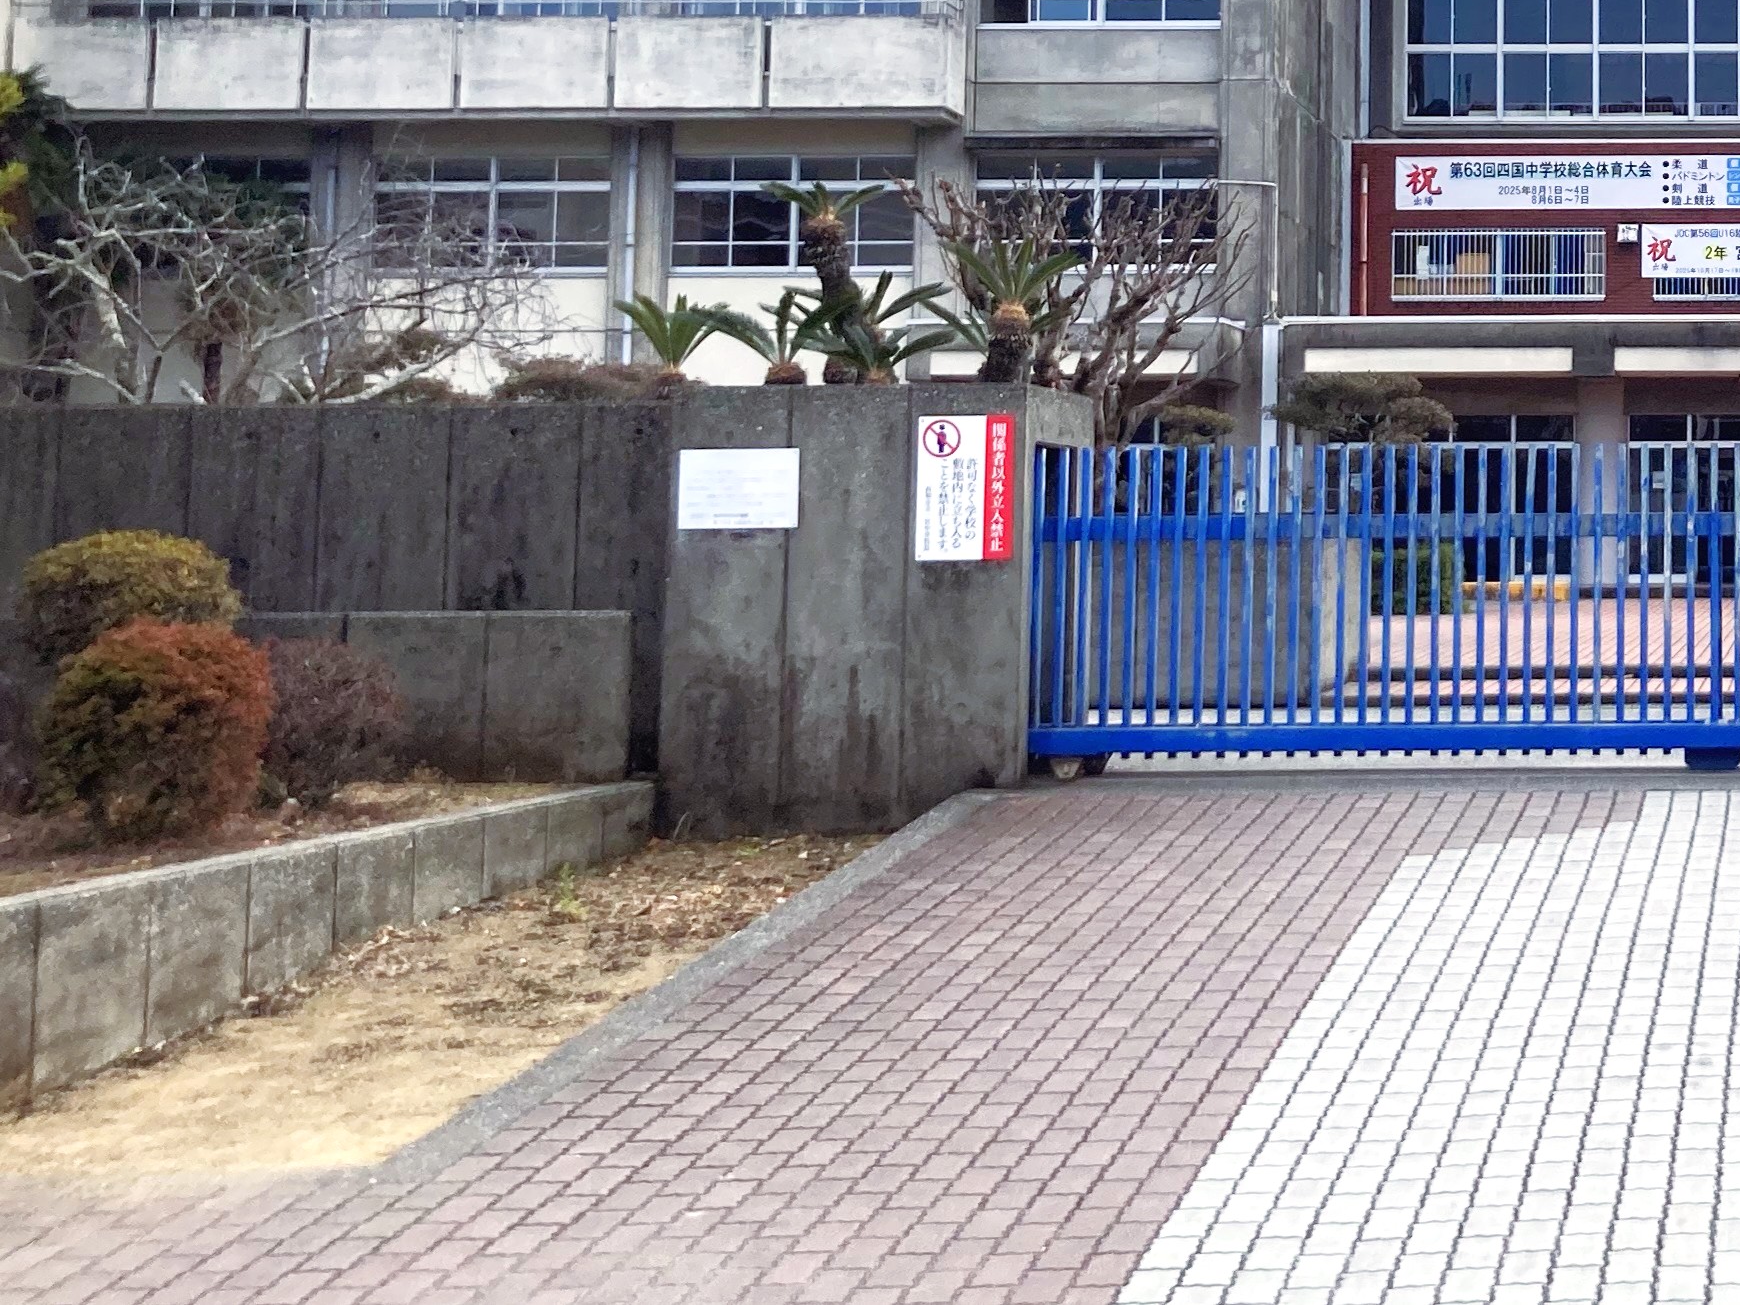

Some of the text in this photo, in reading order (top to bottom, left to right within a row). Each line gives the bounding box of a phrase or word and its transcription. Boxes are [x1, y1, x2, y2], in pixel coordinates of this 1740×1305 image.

[1406, 164, 1442, 195] 祝
[1450, 161, 1652, 179] 第63回四国中学校総合体育大会
[1672, 172, 1725, 181] バドミントン
[1672, 195, 1715, 205] 陸上競技
[1647, 236, 1676, 262] 祝
[1705, 245, 1727, 260] 2年
[991, 423, 1007, 551] 関係者以外立入禁止
[965, 458, 977, 540] 許可なく学校の
